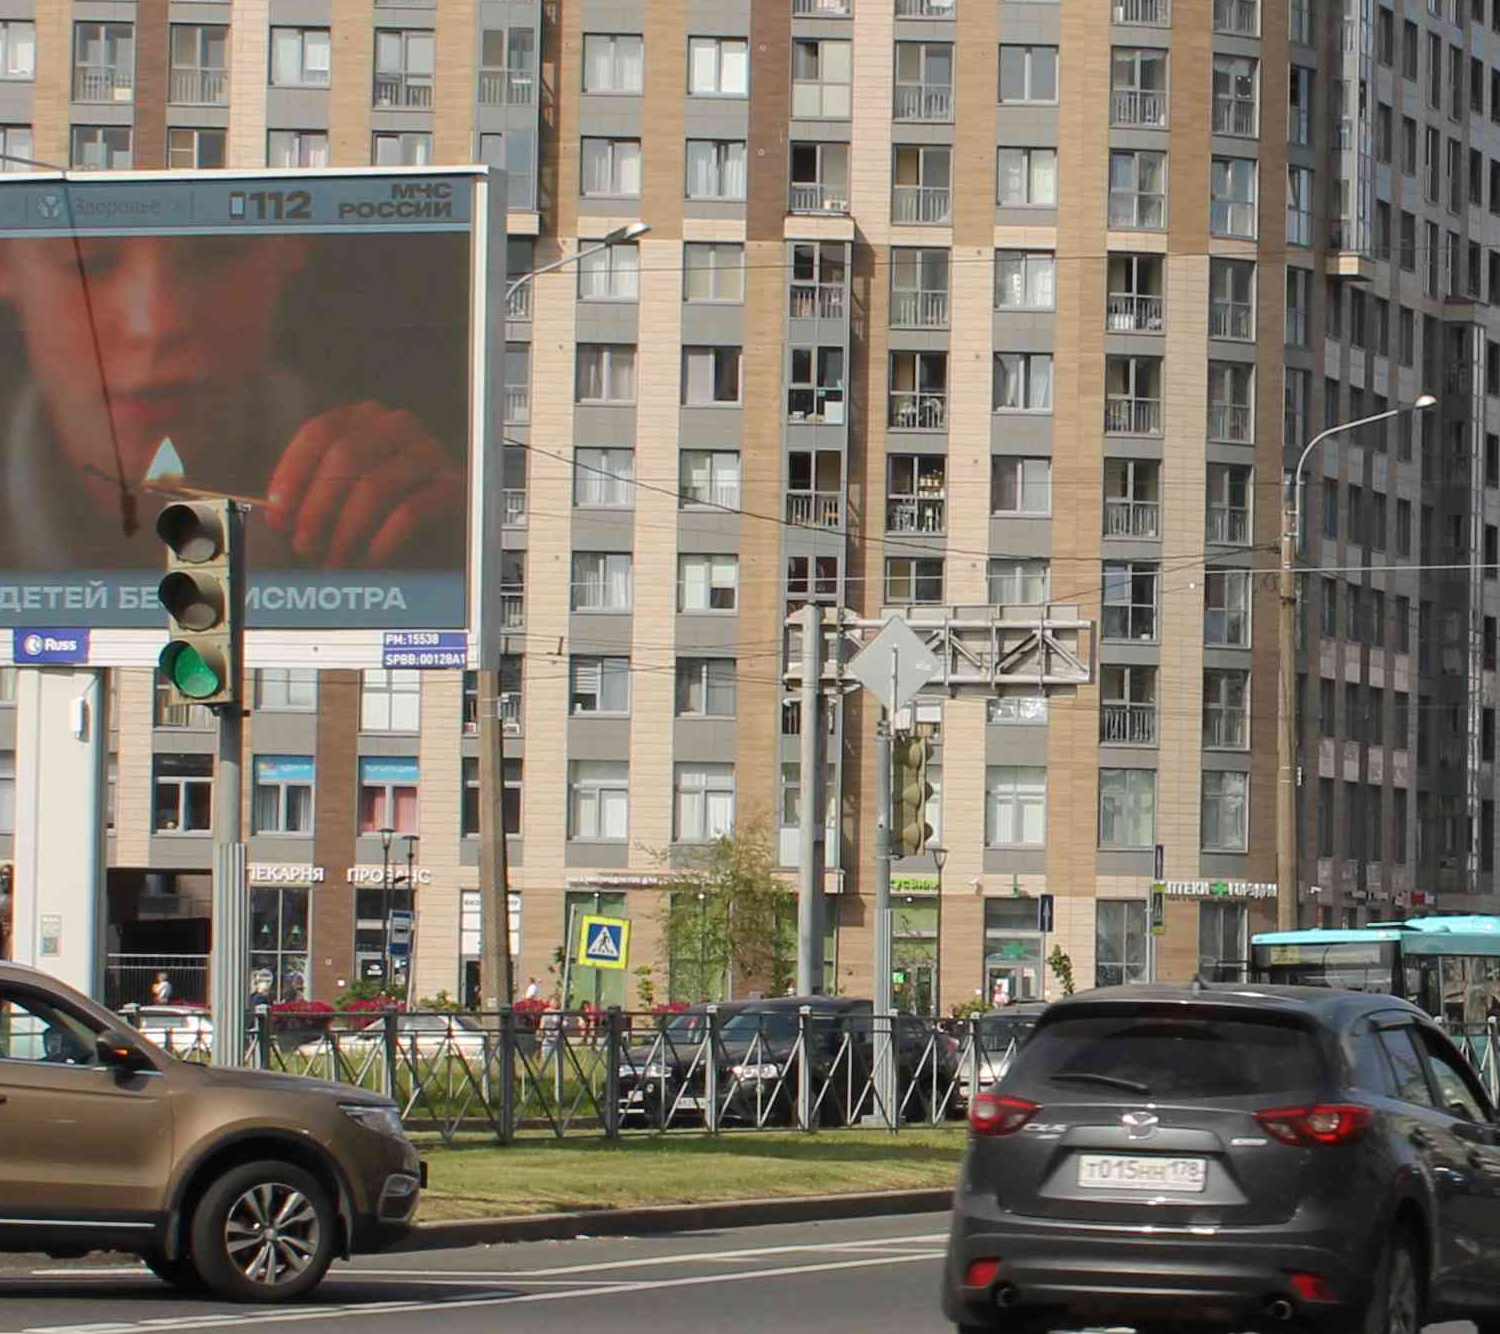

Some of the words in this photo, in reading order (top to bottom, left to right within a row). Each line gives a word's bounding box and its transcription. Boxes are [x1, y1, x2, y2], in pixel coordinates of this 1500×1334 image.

[390, 182, 452, 200] МЧС
[248, 189, 313, 220] 112
[337, 202, 453, 220] РОССИИ
[118, 586, 161, 610] БЕ
[244, 586, 408, 610] ИСМОТРА
[44, 637, 77, 651] Russ
